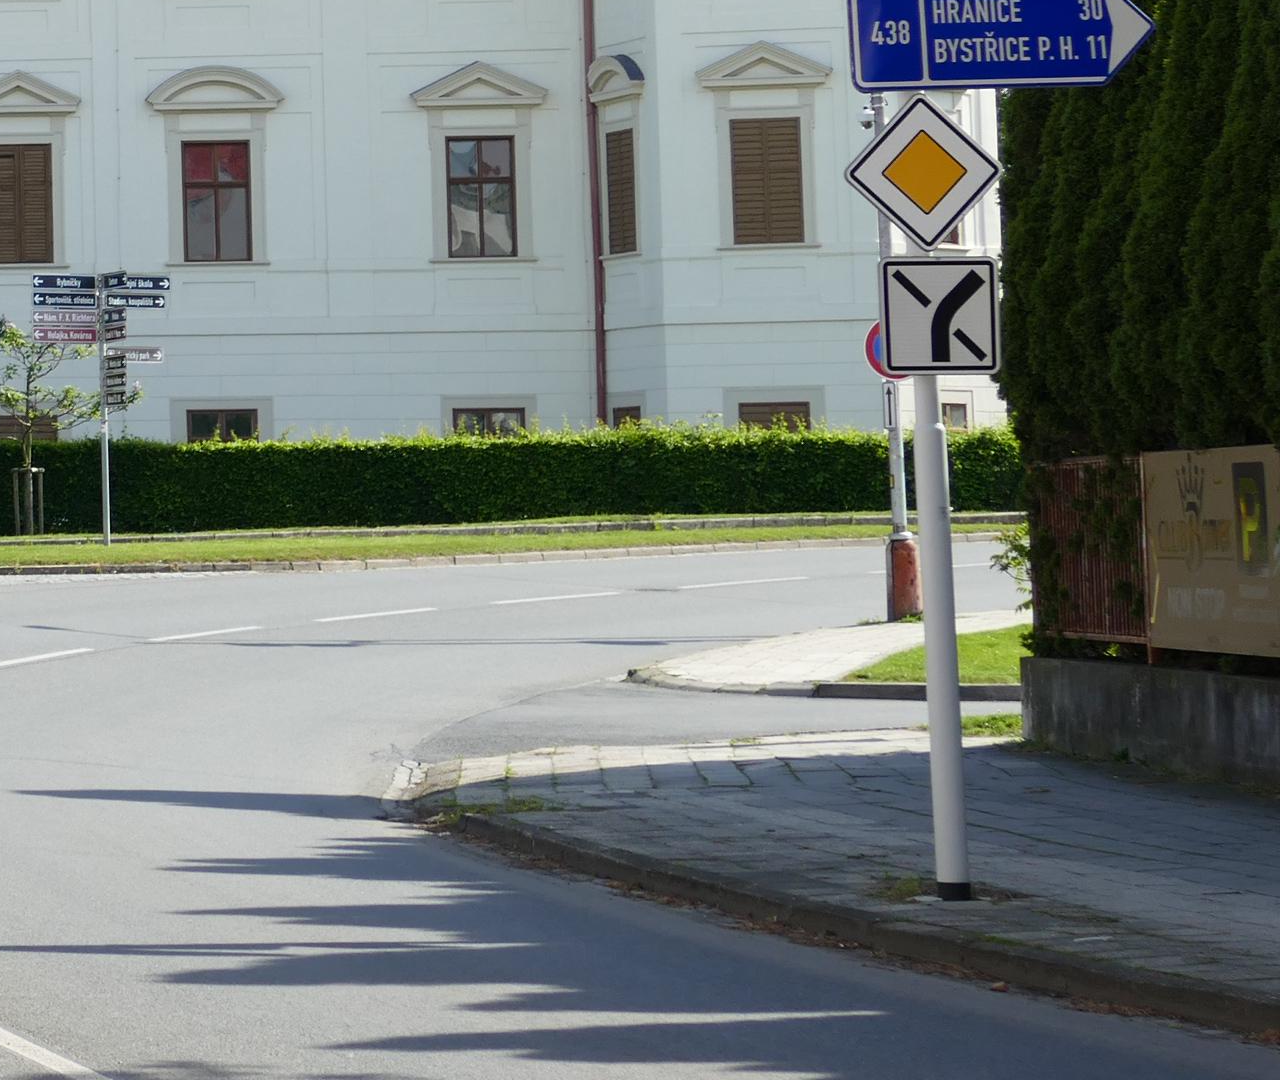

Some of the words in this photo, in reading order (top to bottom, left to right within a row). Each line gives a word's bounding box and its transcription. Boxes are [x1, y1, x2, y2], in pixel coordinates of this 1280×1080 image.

[870, 20, 910, 45] 438
[934, 31, 1031, 63] BYSTŘICE
[1038, 36, 1055, 61] P.
[1059, 36, 1079, 60] H.
[1087, 35, 1107, 59] 11
